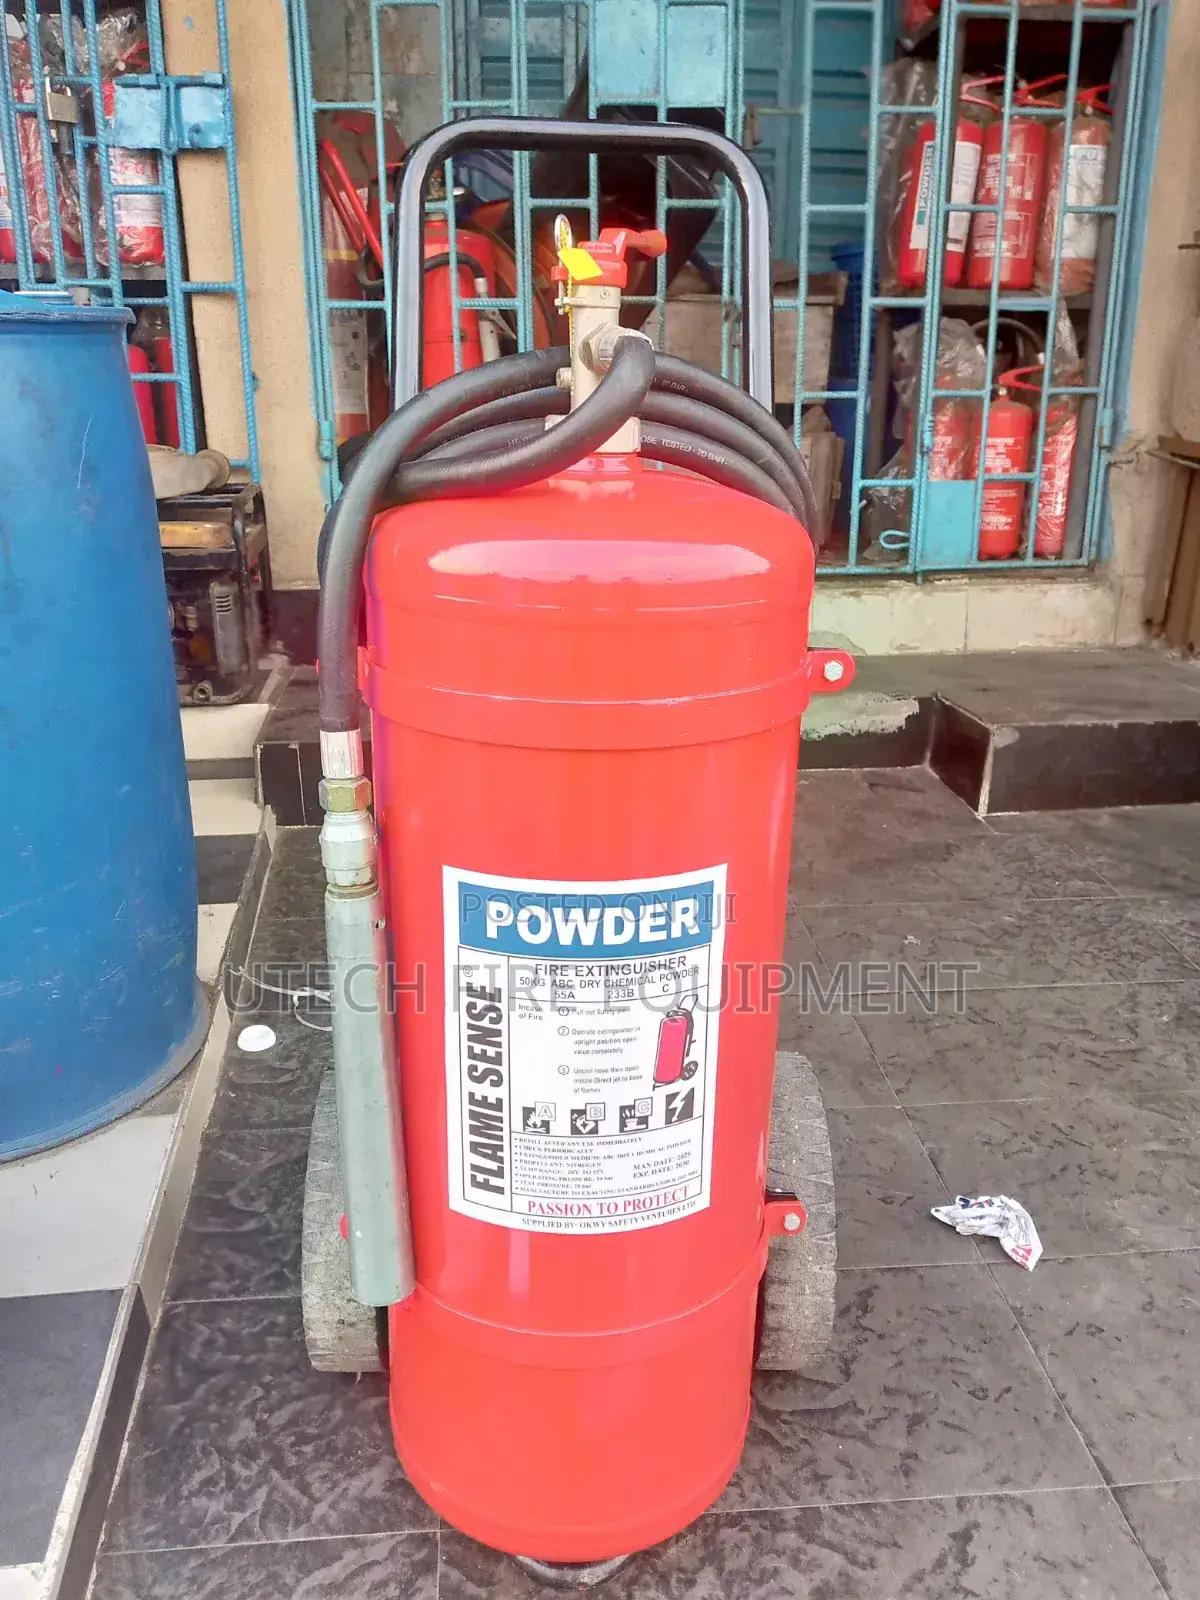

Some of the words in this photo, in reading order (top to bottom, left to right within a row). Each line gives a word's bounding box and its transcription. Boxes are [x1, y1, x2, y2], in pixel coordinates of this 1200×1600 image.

[640, 434, 658, 445] OSE
[662, 438, 692, 452] TESTED
[697, 448, 708, 458] 20
[486, 898, 701, 946] POWDER
[520, 976, 546, 987] 50KG
[551, 980, 574, 988] ABC
[580, 980, 600, 988] DRY
[604, 974, 656, 988] CHEMICAL
[659, 966, 700, 982] POWDER
[535, 963, 569, 977] FIRE
[574, 956, 687, 978] EXTINGUISHER
[554, 990, 576, 1000] 55A
[608, 988, 635, 999] 233B
[662, 984, 670, 993] C
[518, 1004, 543, 1012] Incase
[466, 981, 504, 1088] SENSE
[574, 1038, 596, 1046] upright
[596, 1038, 622, 1046] position
[591, 1047, 624, 1055] completely
[624, 1065, 640, 1073] open
[468, 1090, 505, 1196] FLAME
[632, 1162, 652, 1171] MAN
[528, 1200, 592, 1217] PASSION
[596, 1201, 619, 1216] TO
[622, 1184, 690, 1213] PROTECT
[522, 1218, 562, 1229] SUPPLIED
[608, 1216, 640, 1228] SAFETY
[640, 1205, 682, 1223] VENTURES
